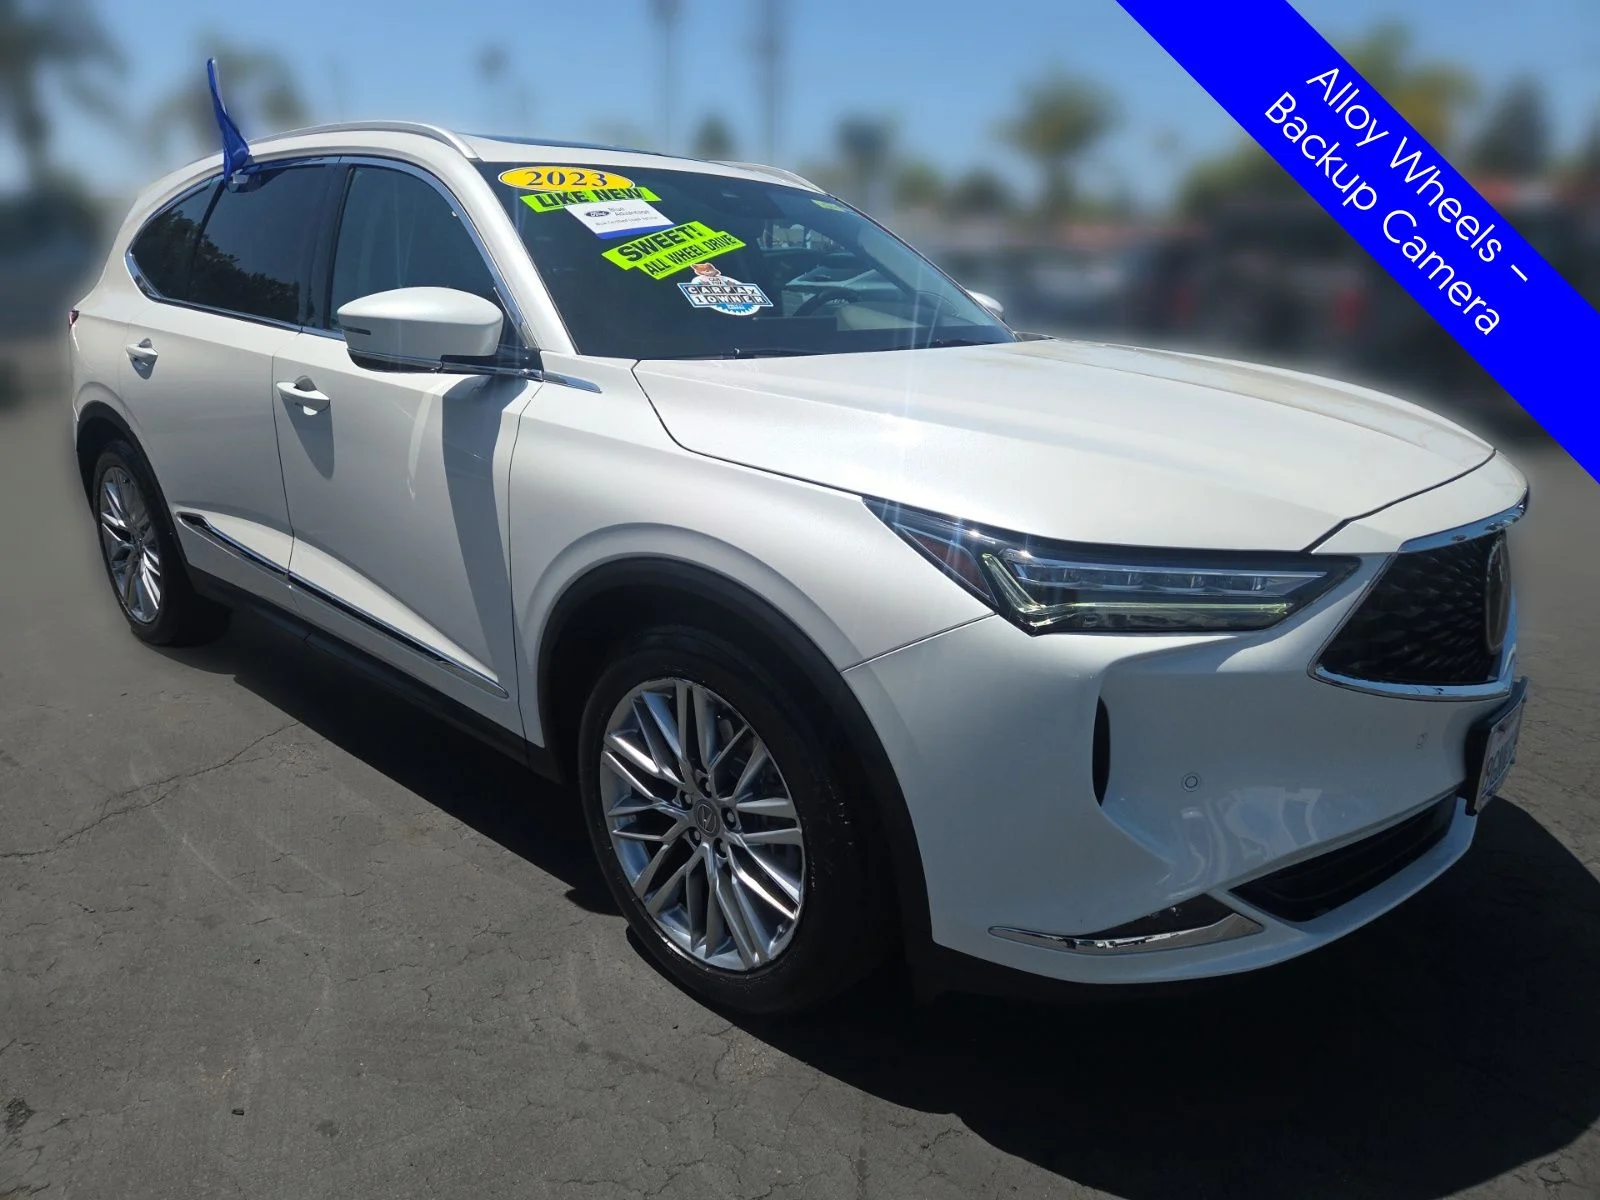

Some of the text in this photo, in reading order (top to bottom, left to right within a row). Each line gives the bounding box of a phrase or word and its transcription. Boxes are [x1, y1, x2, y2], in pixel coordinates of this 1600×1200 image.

[525, 171, 608, 187] 2023
[534, 187, 645, 208] LIKE NEW
[618, 225, 703, 262] SWEET!
[644, 234, 737, 275] ALL WHEEL DRIVE
[687, 286, 758, 294] CARFAX
[707, 295, 765, 303] OWNER
